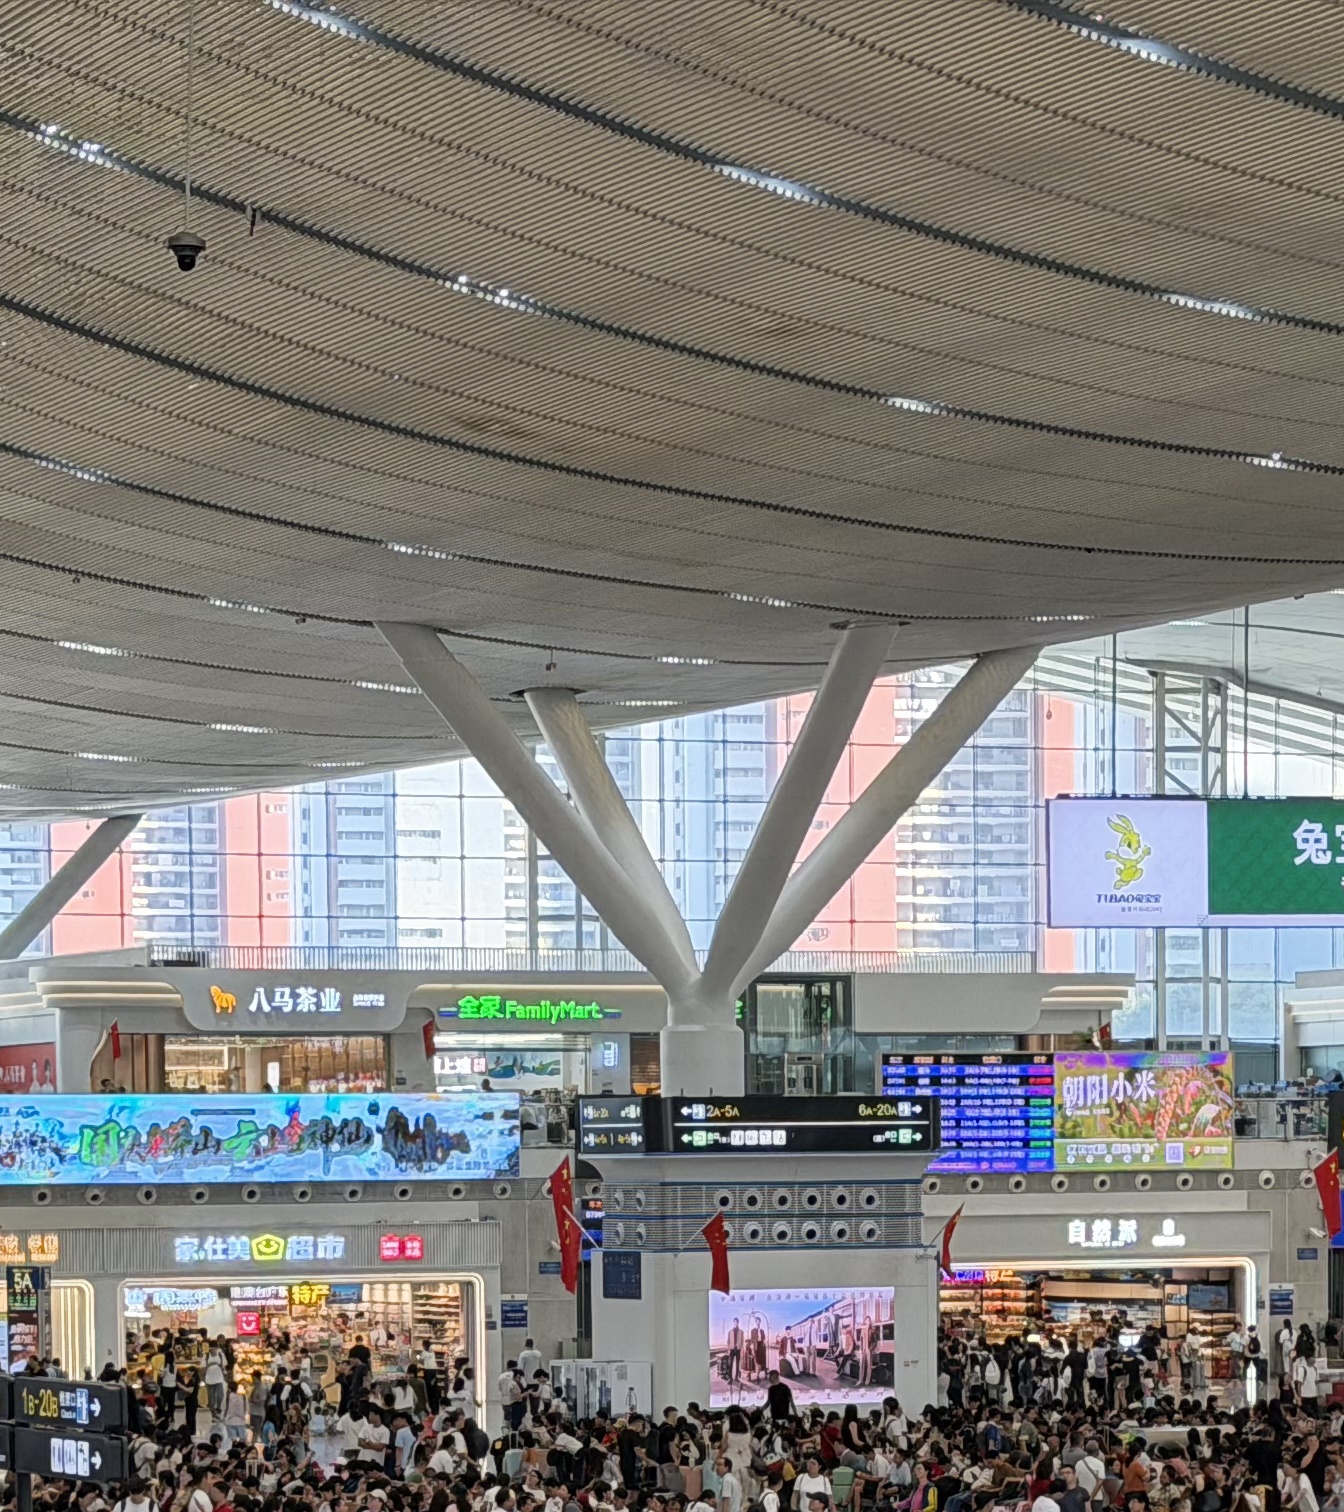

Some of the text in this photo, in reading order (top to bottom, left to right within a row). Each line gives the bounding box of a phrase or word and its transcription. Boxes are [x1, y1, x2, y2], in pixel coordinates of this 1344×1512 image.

[249, 987, 341, 1014] 八马茶业
[458, 995, 504, 1018] 全家
[1062, 1069, 1156, 1108] 朝阳小米
[706, 1103, 897, 1118] 2A-5A 6A-20A
[1068, 1218, 1138, 1244] 自然派
[286, 1234, 346, 1261] 超市
[13, 1274, 33, 1291] 5A
[291, 1284, 330, 1305] 特产
[21, 1387, 59, 1418] 1B-20B
